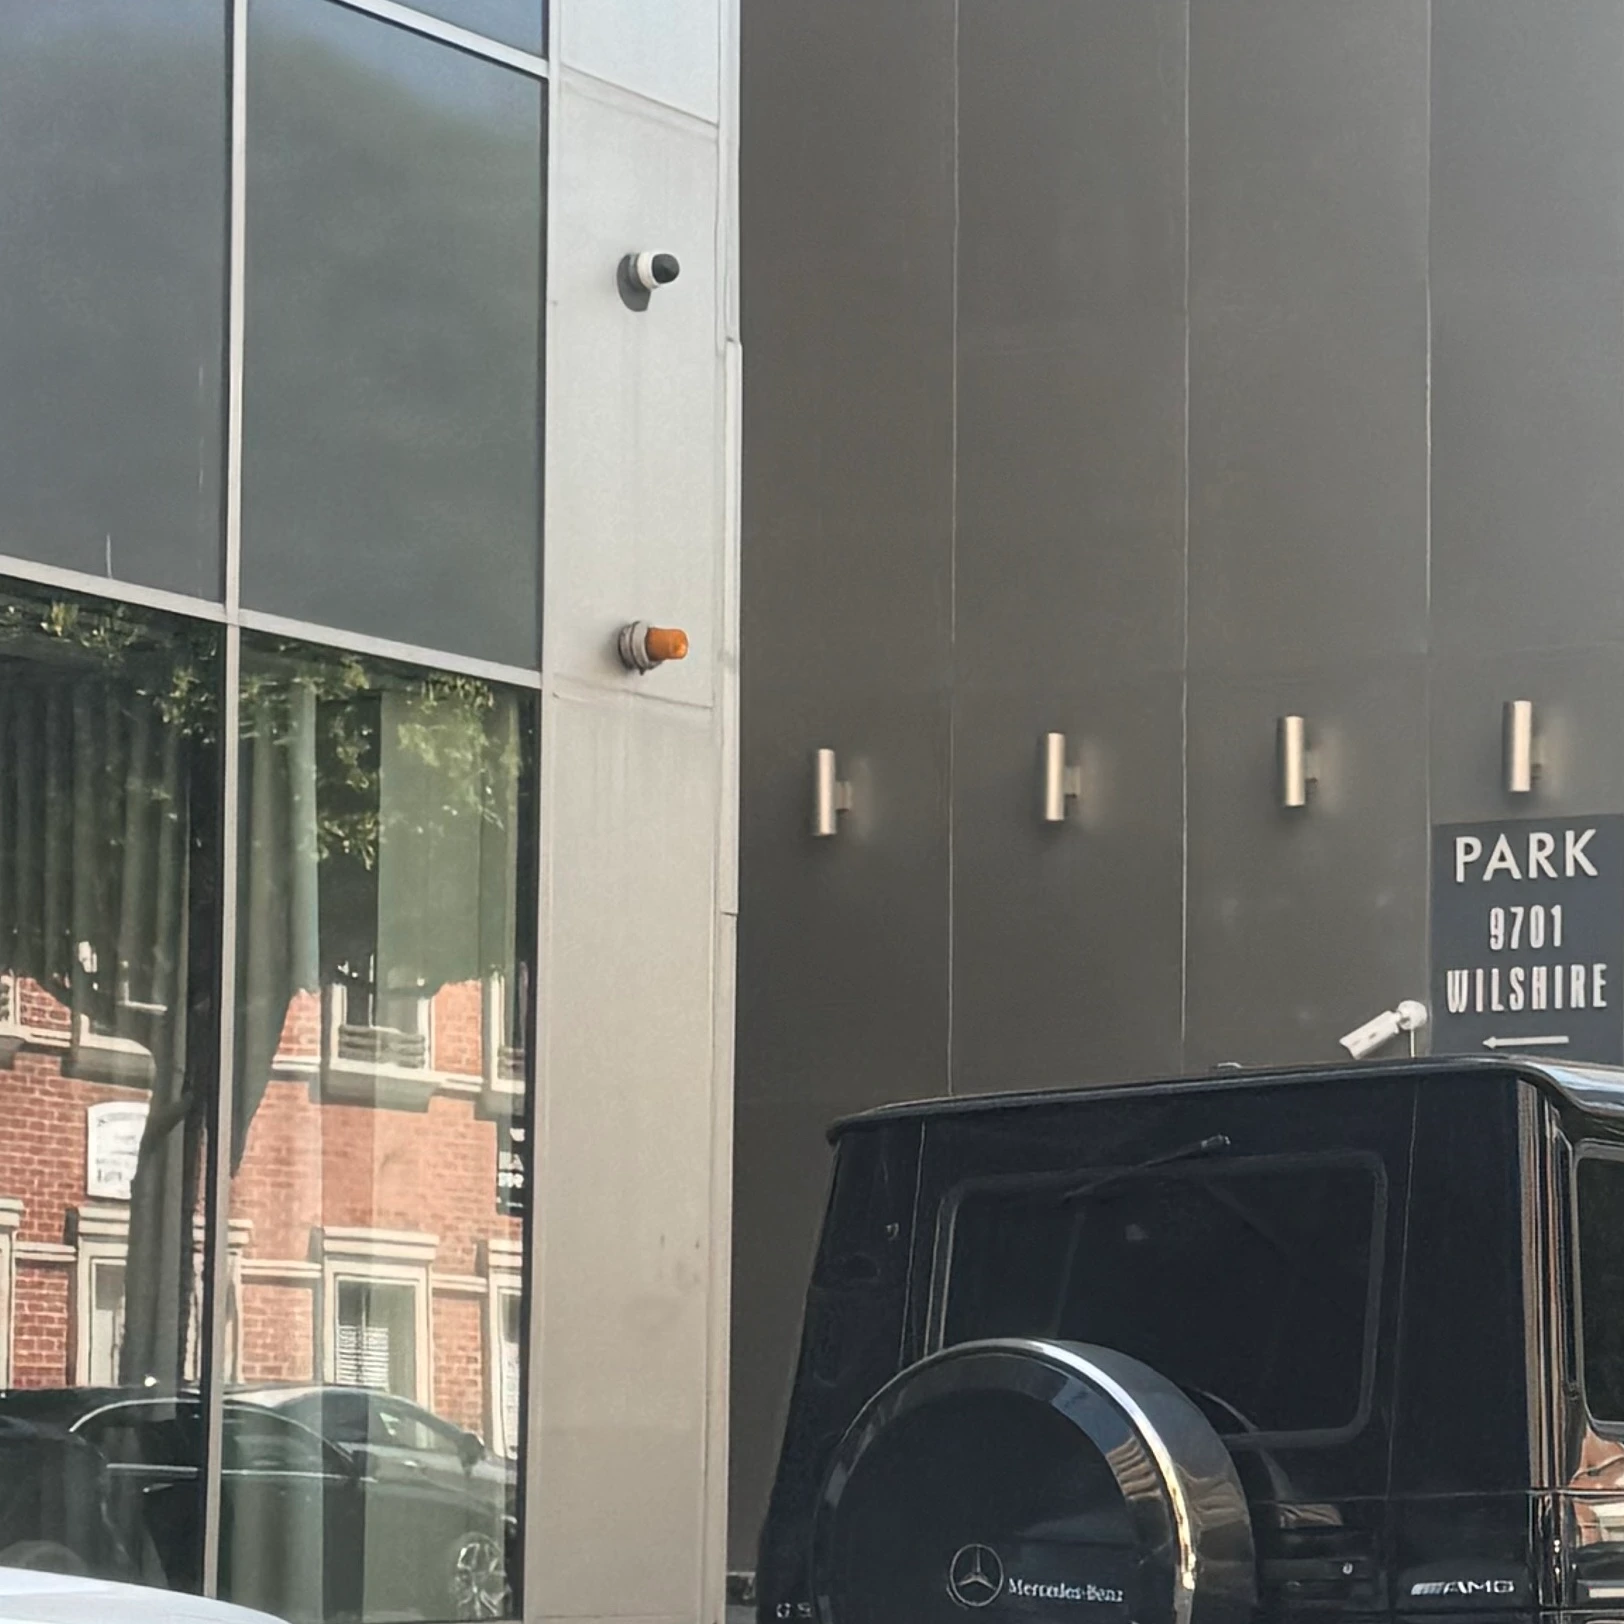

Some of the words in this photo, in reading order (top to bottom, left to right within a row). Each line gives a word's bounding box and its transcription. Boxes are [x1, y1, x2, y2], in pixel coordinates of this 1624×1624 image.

[1455, 828, 1598, 883] PARK
[1489, 904, 1562, 950] 9701
[1446, 962, 1607, 1013] WILSHIRE
[1443, 1580, 1515, 1595] AMG
